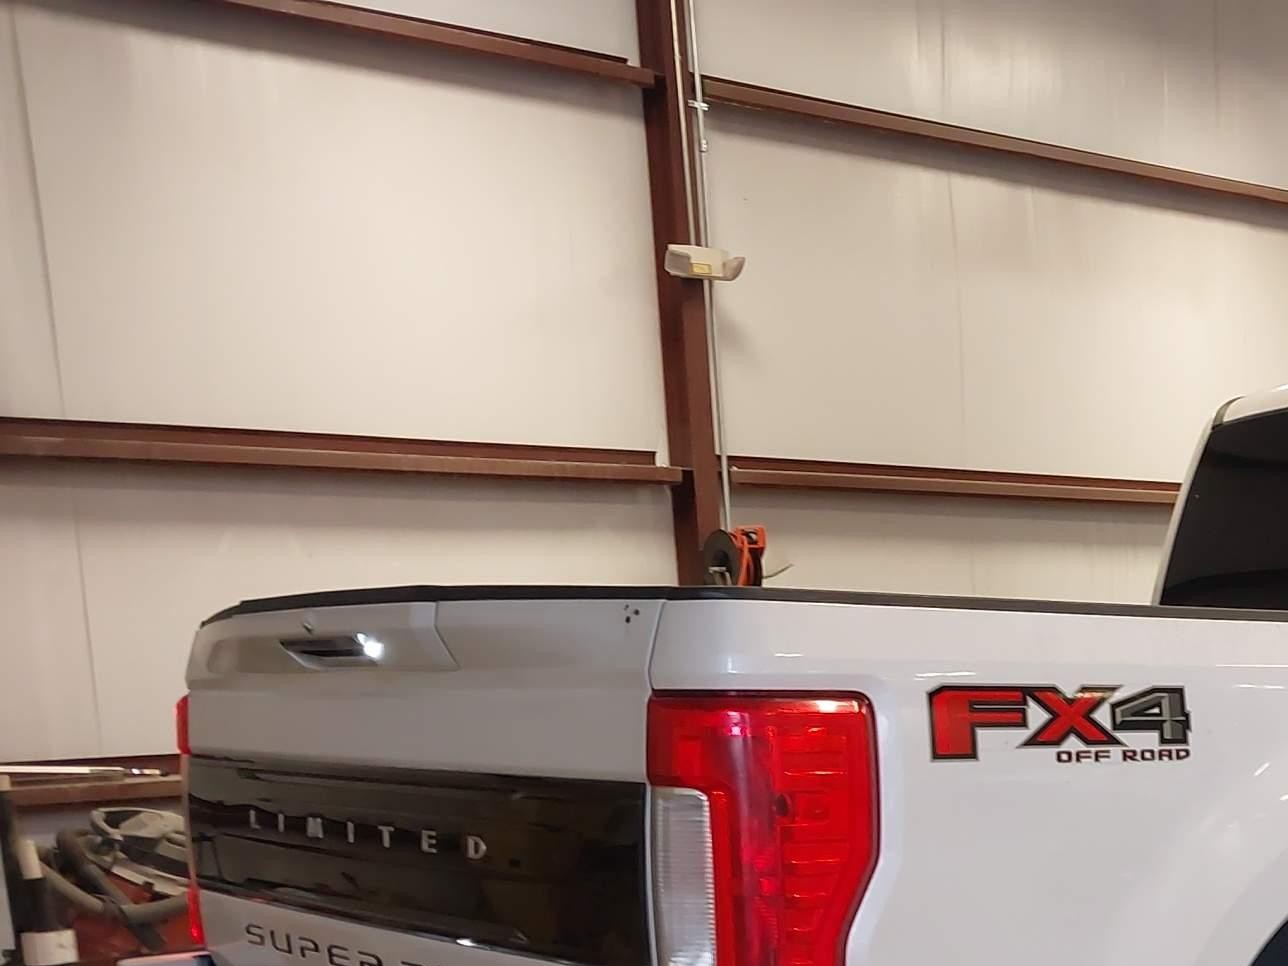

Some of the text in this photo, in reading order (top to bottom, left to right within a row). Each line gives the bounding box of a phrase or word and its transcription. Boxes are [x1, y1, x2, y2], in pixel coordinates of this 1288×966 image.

[927, 684, 1191, 761] FX4
[1056, 748, 1191, 763] OFF ROAD
[249, 809, 488, 860] LIMITED
